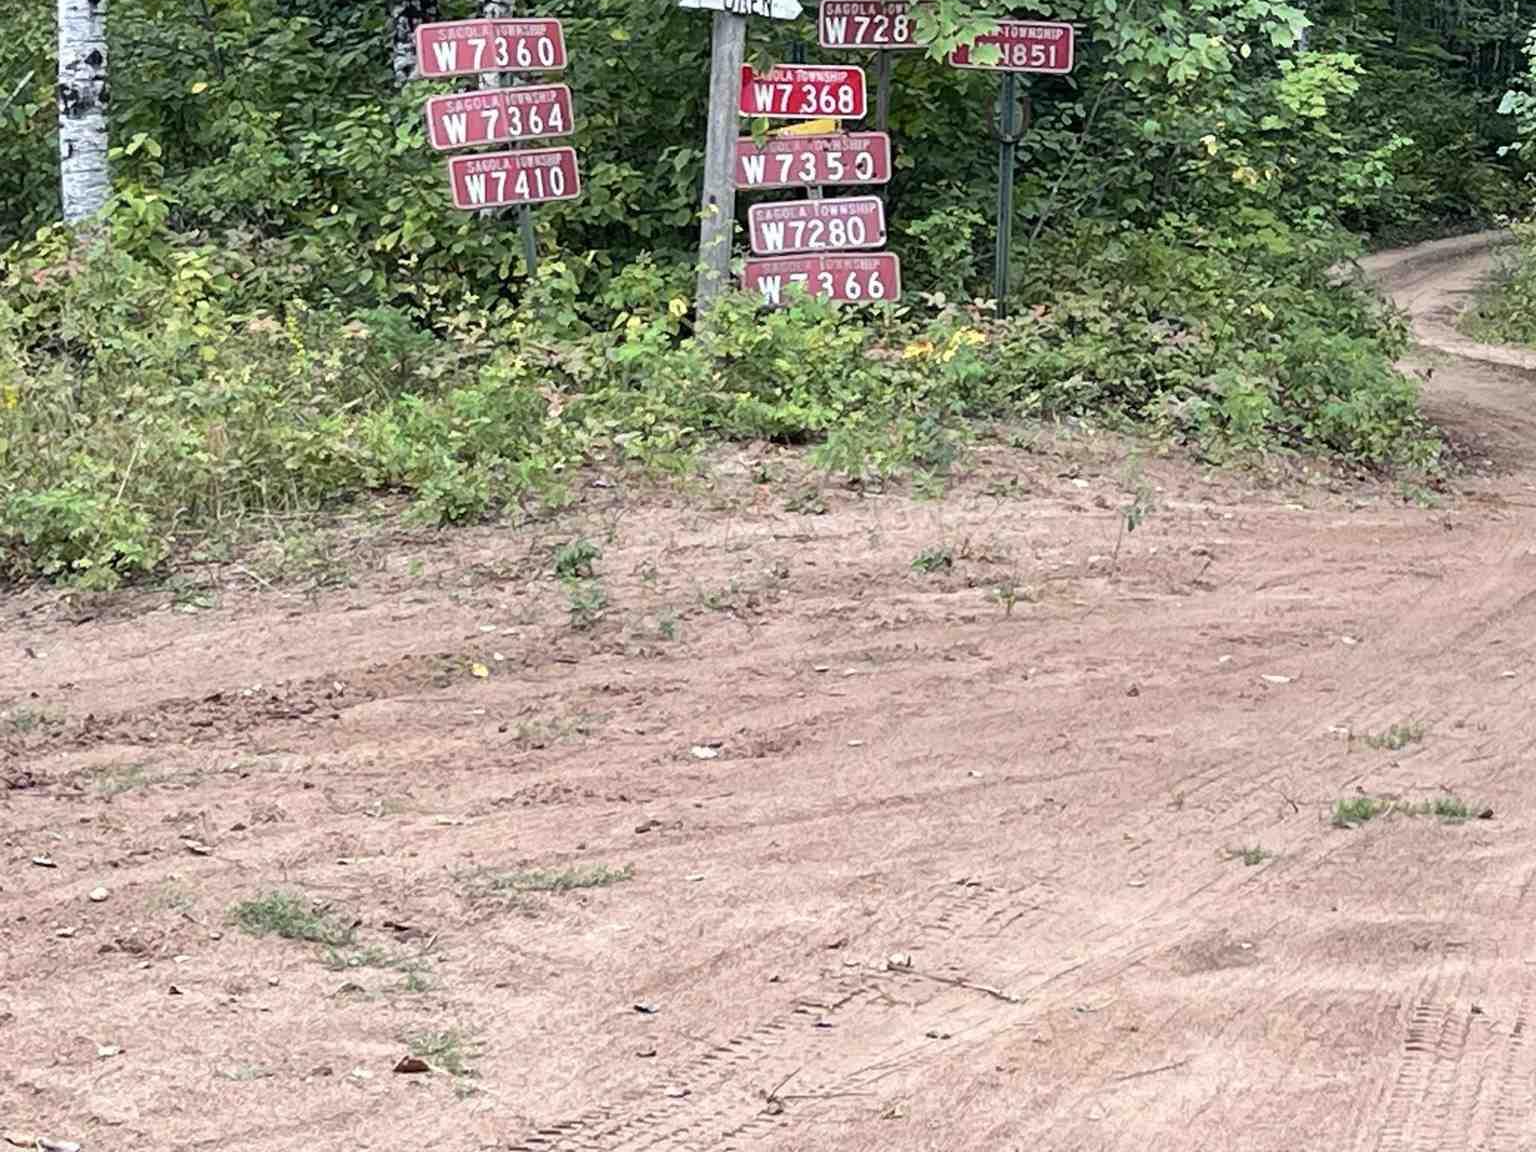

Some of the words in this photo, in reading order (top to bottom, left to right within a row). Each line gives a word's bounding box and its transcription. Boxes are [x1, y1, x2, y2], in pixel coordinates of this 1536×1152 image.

[826, 3, 876, 16] SAGOLA
[825, 14, 909, 44] W728
[1003, 26, 1064, 40] TOWNSHIP
[795, 69, 848, 82] TOWNSHIP
[447, 96, 501, 113] SAGOLA
[467, 157, 511, 174] SAGOLA
[464, 166, 565, 204] W7410
[815, 202, 877, 217] TOWNSHIP
[760, 216, 866, 251] W7280
